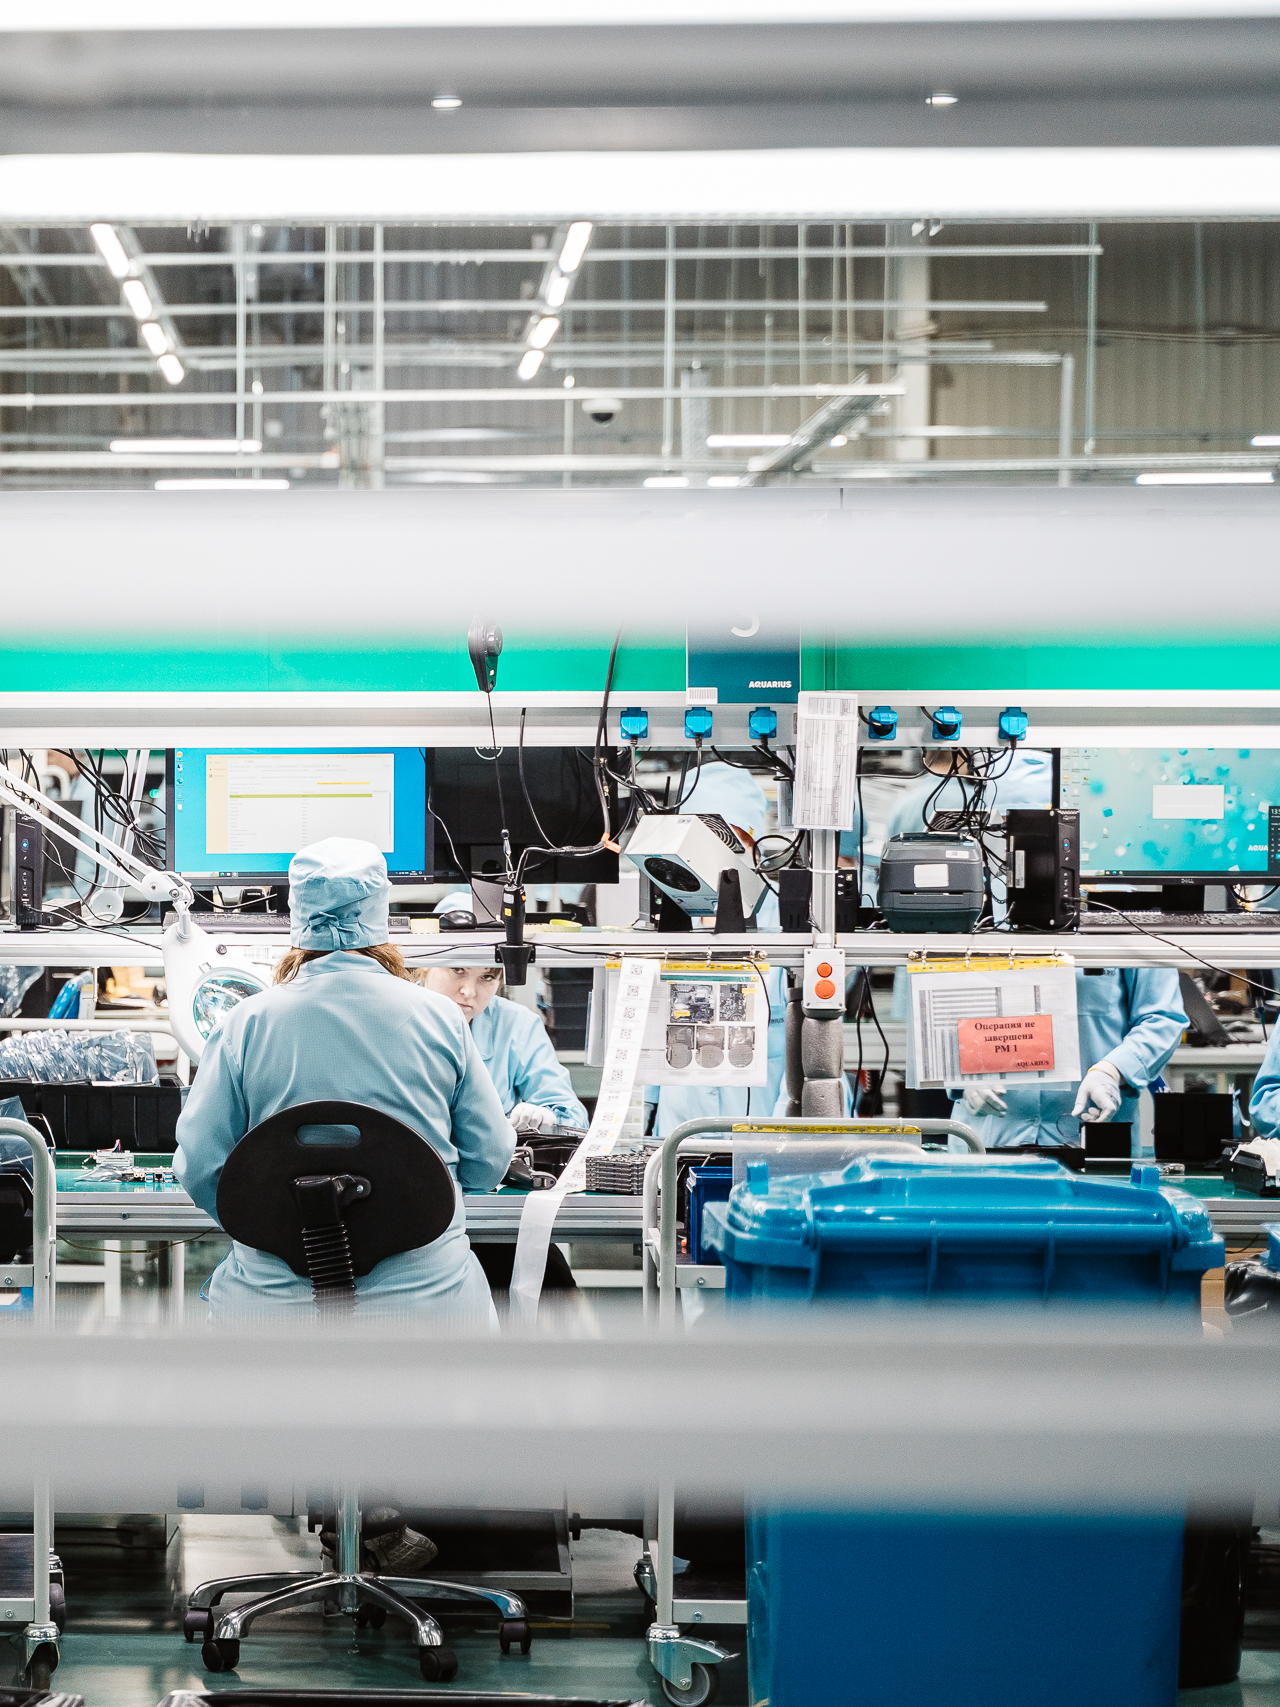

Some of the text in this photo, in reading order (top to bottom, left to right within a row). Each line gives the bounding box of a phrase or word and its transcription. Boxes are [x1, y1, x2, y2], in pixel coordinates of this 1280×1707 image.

[748, 680, 792, 689] AQUARIUS
[975, 1022, 1022, 1031] Операция
[984, 1033, 1034, 1043] завершена
[1016, 1060, 1049, 1068] AQUARIUS
